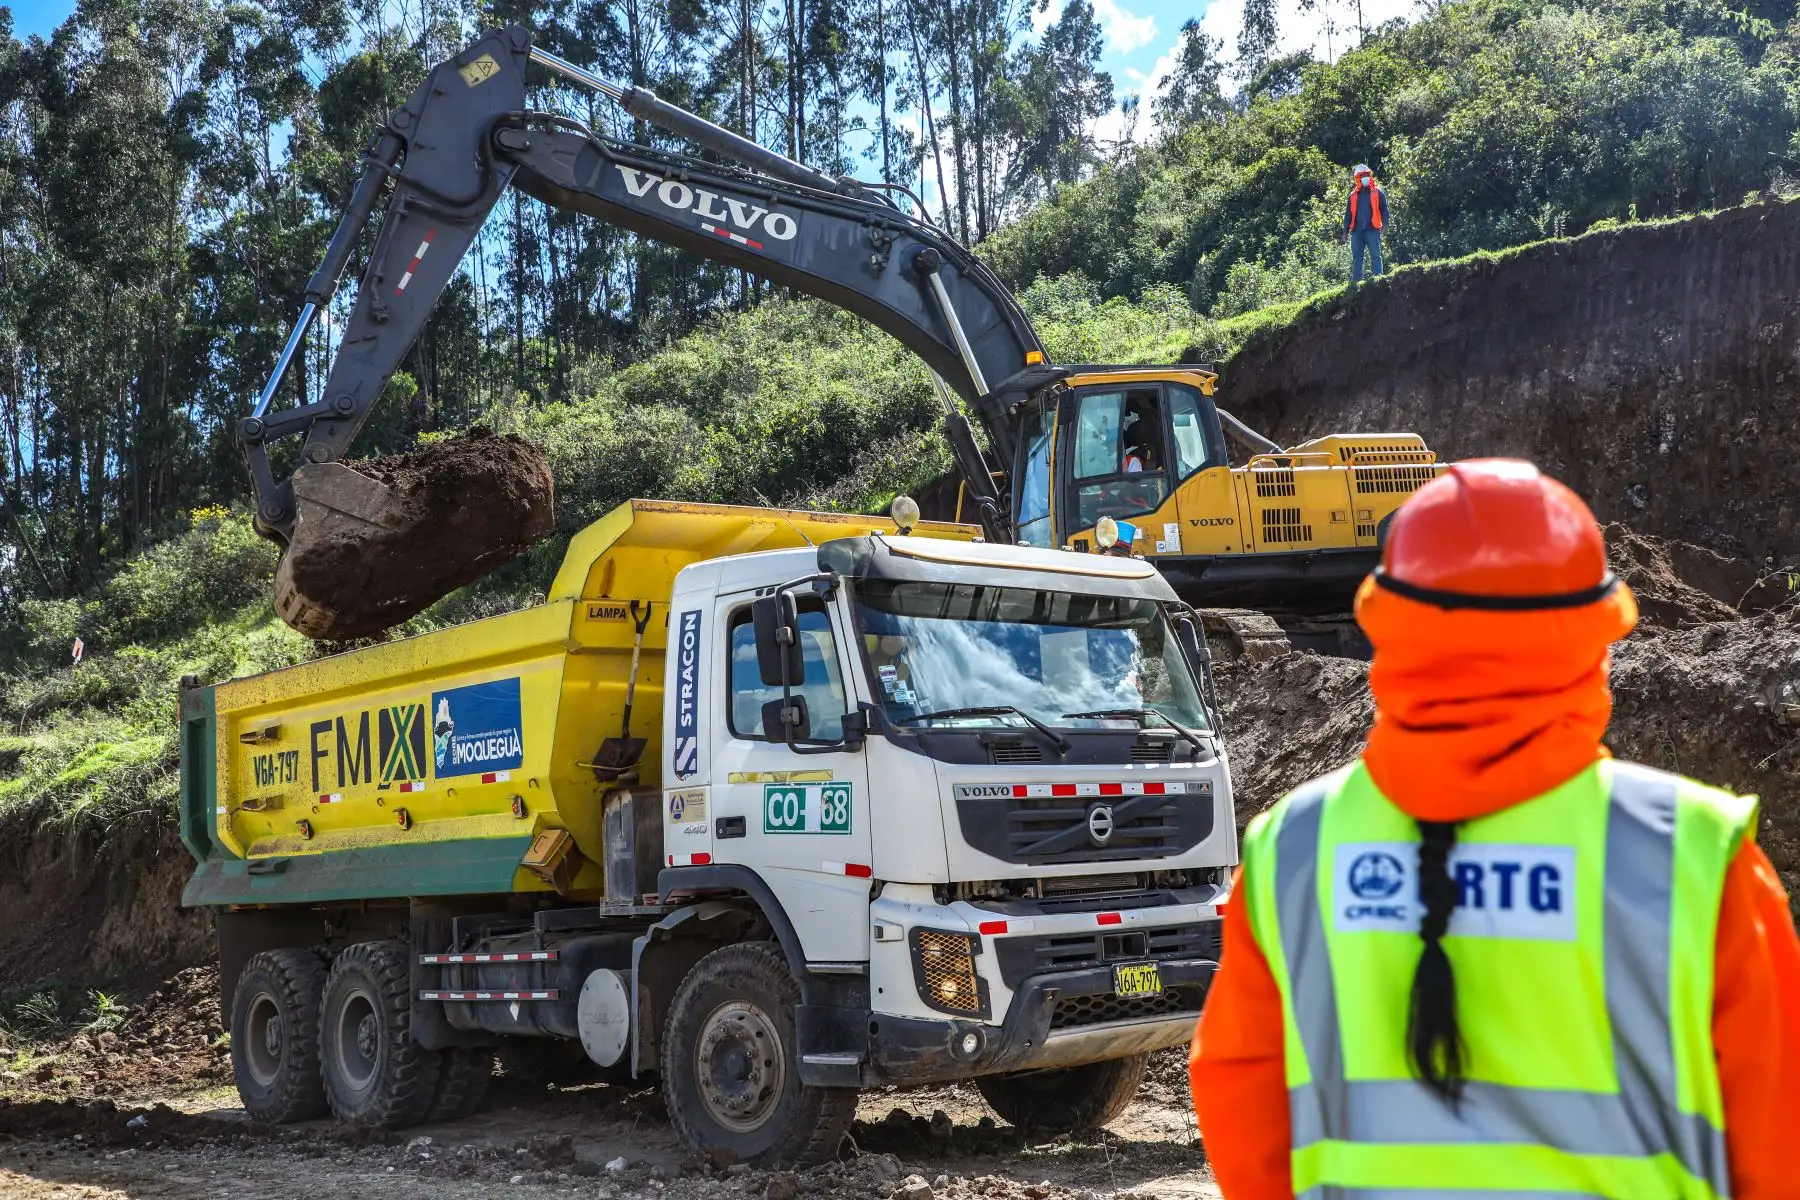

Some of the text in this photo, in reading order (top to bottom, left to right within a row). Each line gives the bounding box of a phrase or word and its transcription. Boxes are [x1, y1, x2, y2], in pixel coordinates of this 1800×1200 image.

[615, 164, 797, 241] VOLVO
[1189, 517, 1234, 527] VOLVO
[589, 607, 626, 619] LAMPA
[681, 613, 697, 728] STRACON
[310, 704, 427, 793] FMX
[456, 728, 522, 764] MOQUEGUA
[253, 750, 299, 788] V6A-797
[961, 786, 1010, 797] VOLVO
[1418, 862, 1563, 915] RTG
[1117, 970, 1158, 992] V6A-797
